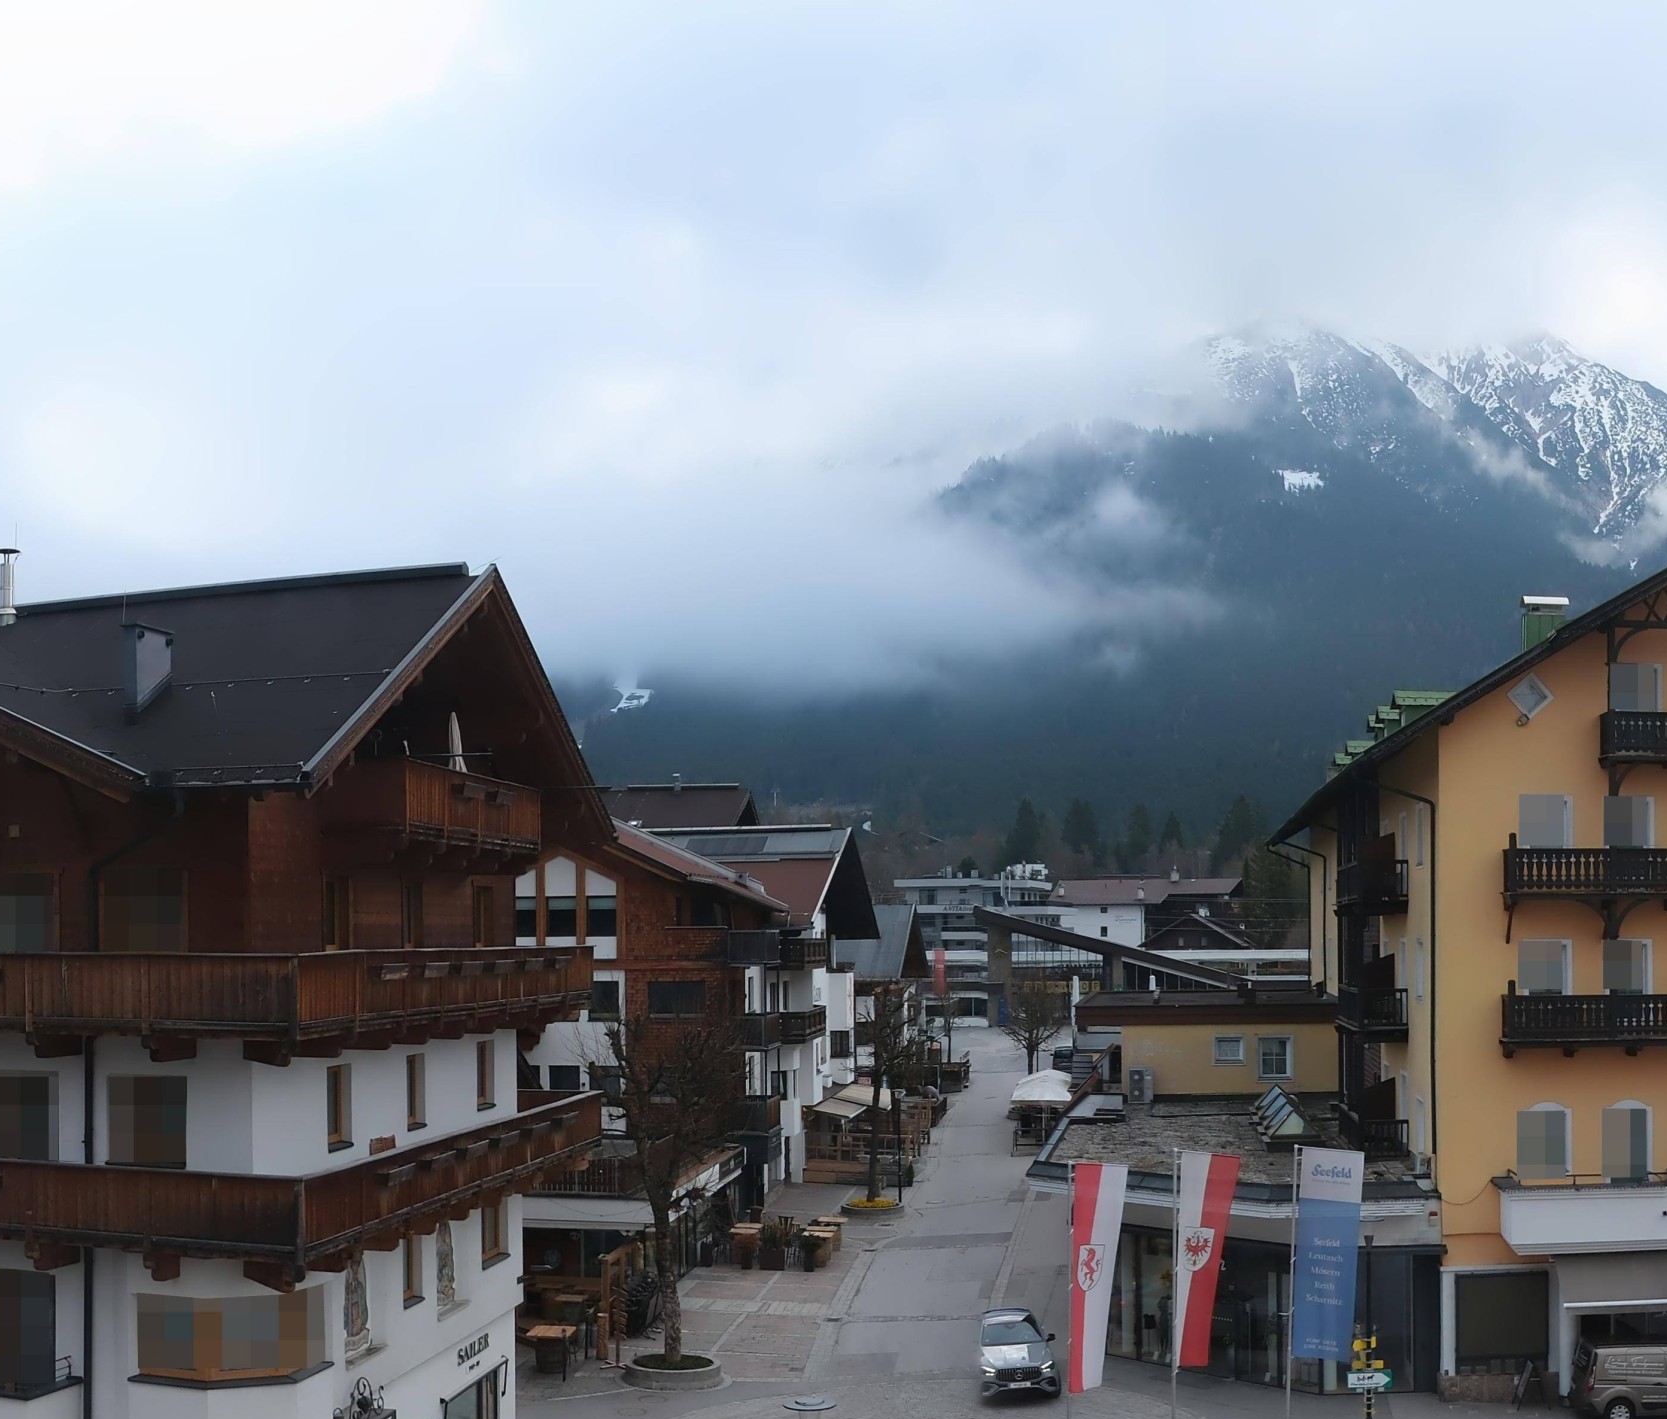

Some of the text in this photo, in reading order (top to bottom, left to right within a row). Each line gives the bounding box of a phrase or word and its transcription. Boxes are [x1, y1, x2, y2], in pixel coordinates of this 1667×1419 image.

[1312, 1164, 1351, 1178] Seefeld
[1314, 1237, 1340, 1248] Seefeld
[1309, 1251, 1343, 1263] Leutasch
[457, 1332, 489, 1366] SAILER
